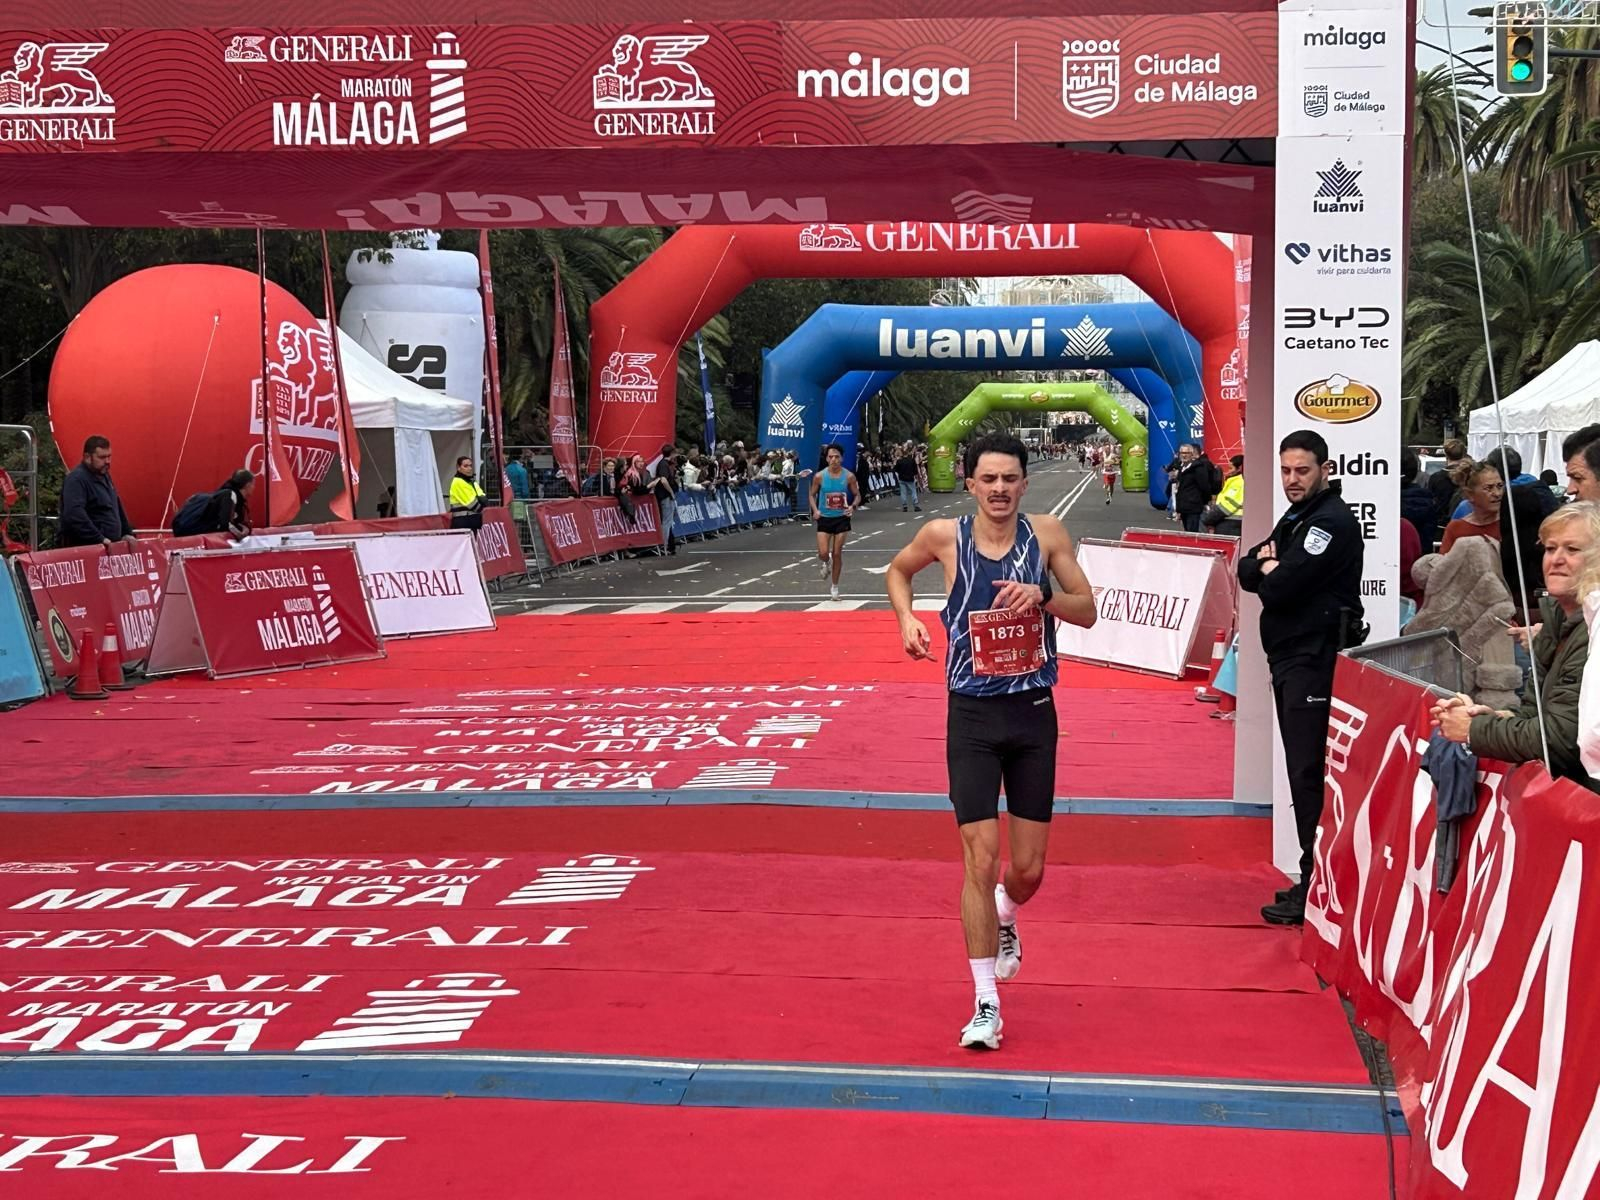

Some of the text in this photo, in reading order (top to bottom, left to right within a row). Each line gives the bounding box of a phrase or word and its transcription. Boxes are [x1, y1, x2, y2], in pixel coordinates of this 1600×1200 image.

[270, 35, 413, 63] GENERALI
[1134, 53, 1221, 76] Ciudad
[341, 75, 412, 98] MARATÓN
[1134, 80, 1258, 106] de Málaga
[1334, 91, 1370, 101] Ciudad
[1334, 102, 1385, 113] de Málaga
[0, 118, 116, 142] GENERALI
[272, 93, 420, 146] MÁLAGA
[594, 112, 716, 136] GENERALI
[1313, 200, 1364, 213] luanvi
[866, 223, 1080, 252] GENERALI
[1317, 243, 1391, 263] vithas
[1284, 307, 1390, 328] BYD
[879, 318, 1045, 359] luanvi
[1284, 335, 1389, 349] Caetano Tec
[600, 390, 657, 403] GENERALI
[1304, 394, 1371, 407] Gourmet
[768, 425, 805, 438] luanvi
[1328, 452, 1389, 475] aldin
[1346, 503, 1376, 521] ER
[1363, 522, 1377, 539] E
[244, 566, 309, 590] GENERALI
[1100, 588, 1190, 631] GENERALI
[257, 611, 326, 650] MÁLAGA
[988, 625, 1025, 640] 1873
[423, 736, 817, 754] GENERALI
[354, 760, 678, 773] GENERALI
[96, 857, 514, 873] GENERALI
[263, 873, 481, 885] MARATÓN
[8, 883, 468, 910] MÁLAGA
[8, 1000, 292, 1017] MARATÓN
[0, 1016, 269, 1052] AGA
[0, 1133, 407, 1174] RALI
